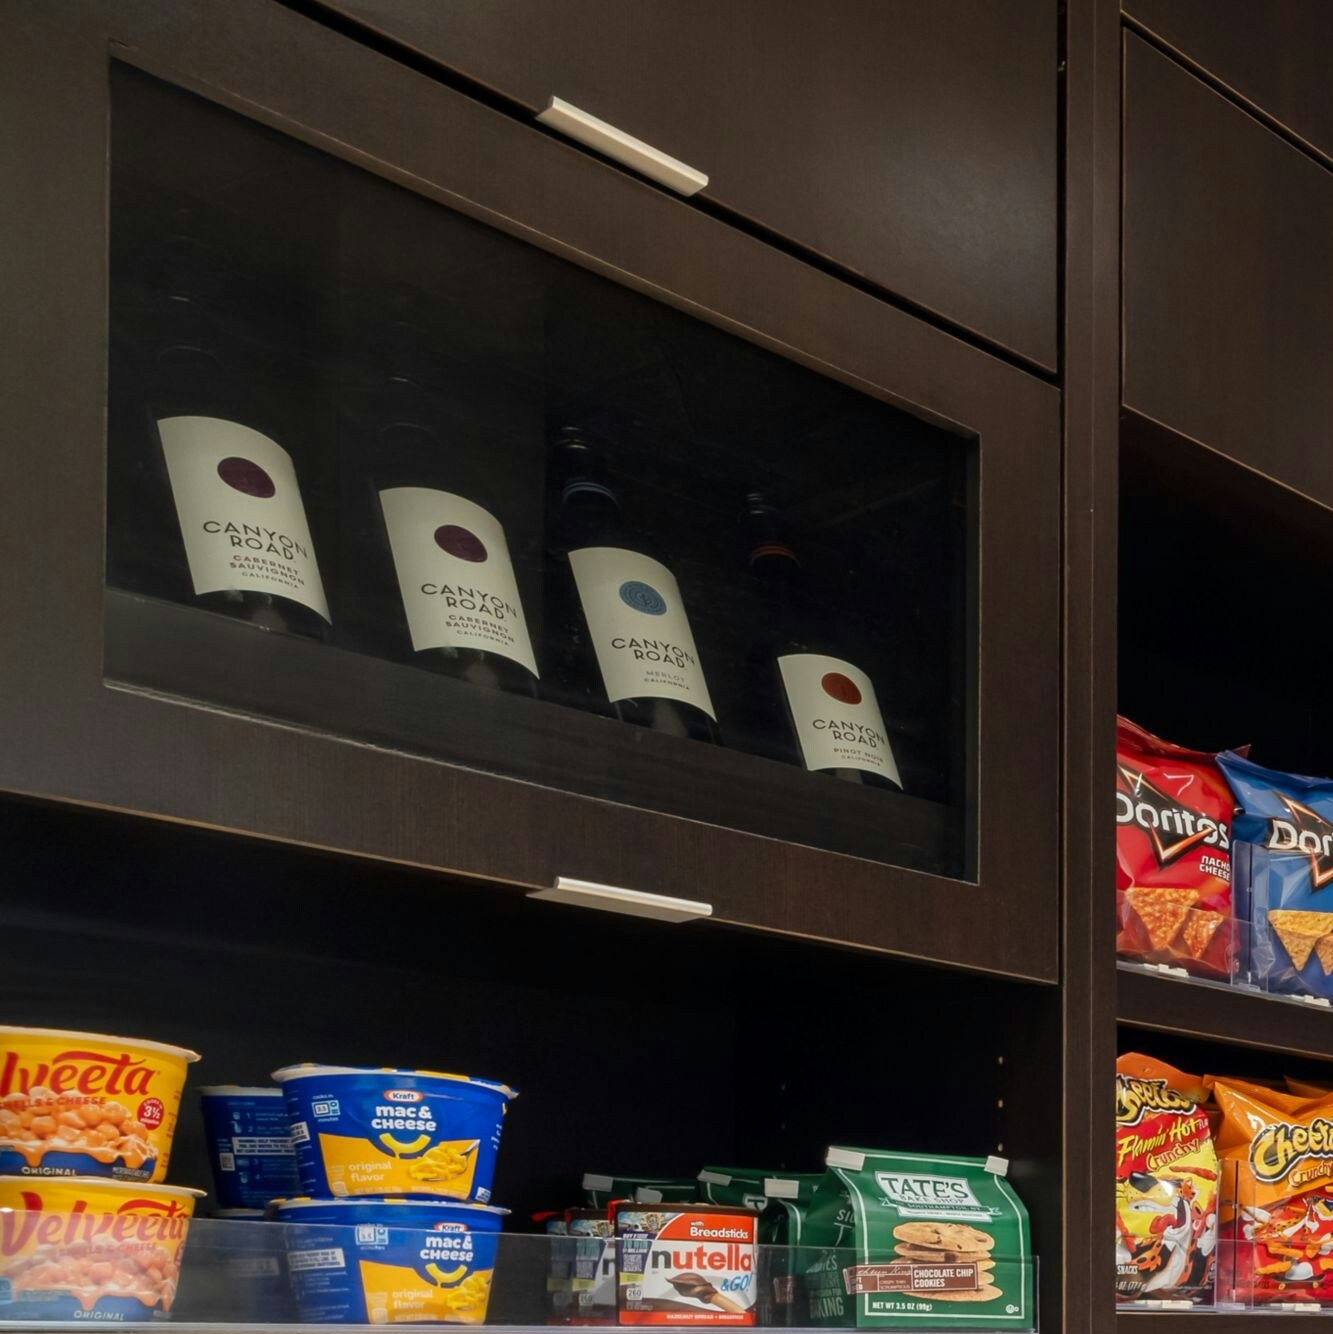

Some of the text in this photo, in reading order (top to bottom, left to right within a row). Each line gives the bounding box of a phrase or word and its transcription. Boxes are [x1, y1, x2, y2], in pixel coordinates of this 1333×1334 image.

[203, 521, 308, 559] CANYON
[230, 535, 294, 560] ROAD
[229, 562, 305, 586] SAUVIGNON
[233, 555, 299, 575] CABERNET
[421, 583, 518, 618] CANYON
[446, 596, 504, 619] ROAD
[445, 621, 515, 643] SAUVIGNON
[448, 614, 509, 634] CABERNET
[611, 638, 695, 665] CANYON
[633, 650, 685, 668] ROAD
[646, 670, 685, 682] MERLOT
[812, 719, 885, 745] CANYON
[833, 731, 877, 748] ROAD
[1116, 793, 1230, 849] Doritos
[1200, 864, 1231, 881] CHEESE
[1202, 855, 1230, 871] NACHO
[392, 1092, 414, 1101] Kraft
[375, 1105, 432, 1119] mac &
[1169, 1117, 1202, 1144] Hot
[1146, 1137, 1201, 1172] Crunchy
[21, 1167, 77, 1176] ORIGINAL
[349, 1161, 392, 1173] original
[351, 1172, 385, 1182] flavor
[881, 1177, 969, 1199] TATE'S
[1, 1191, 188, 1257] Velveeta
[690, 1227, 749, 1239] Breadsticks
[426, 1235, 473, 1250] mac &
[652, 1244, 753, 1272] nutella
[914, 1268, 974, 1279] CHOCOLATE CHIP
[914, 1279, 946, 1288] COOKIES
[73, 1311, 124, 1321] ORIGINAL
